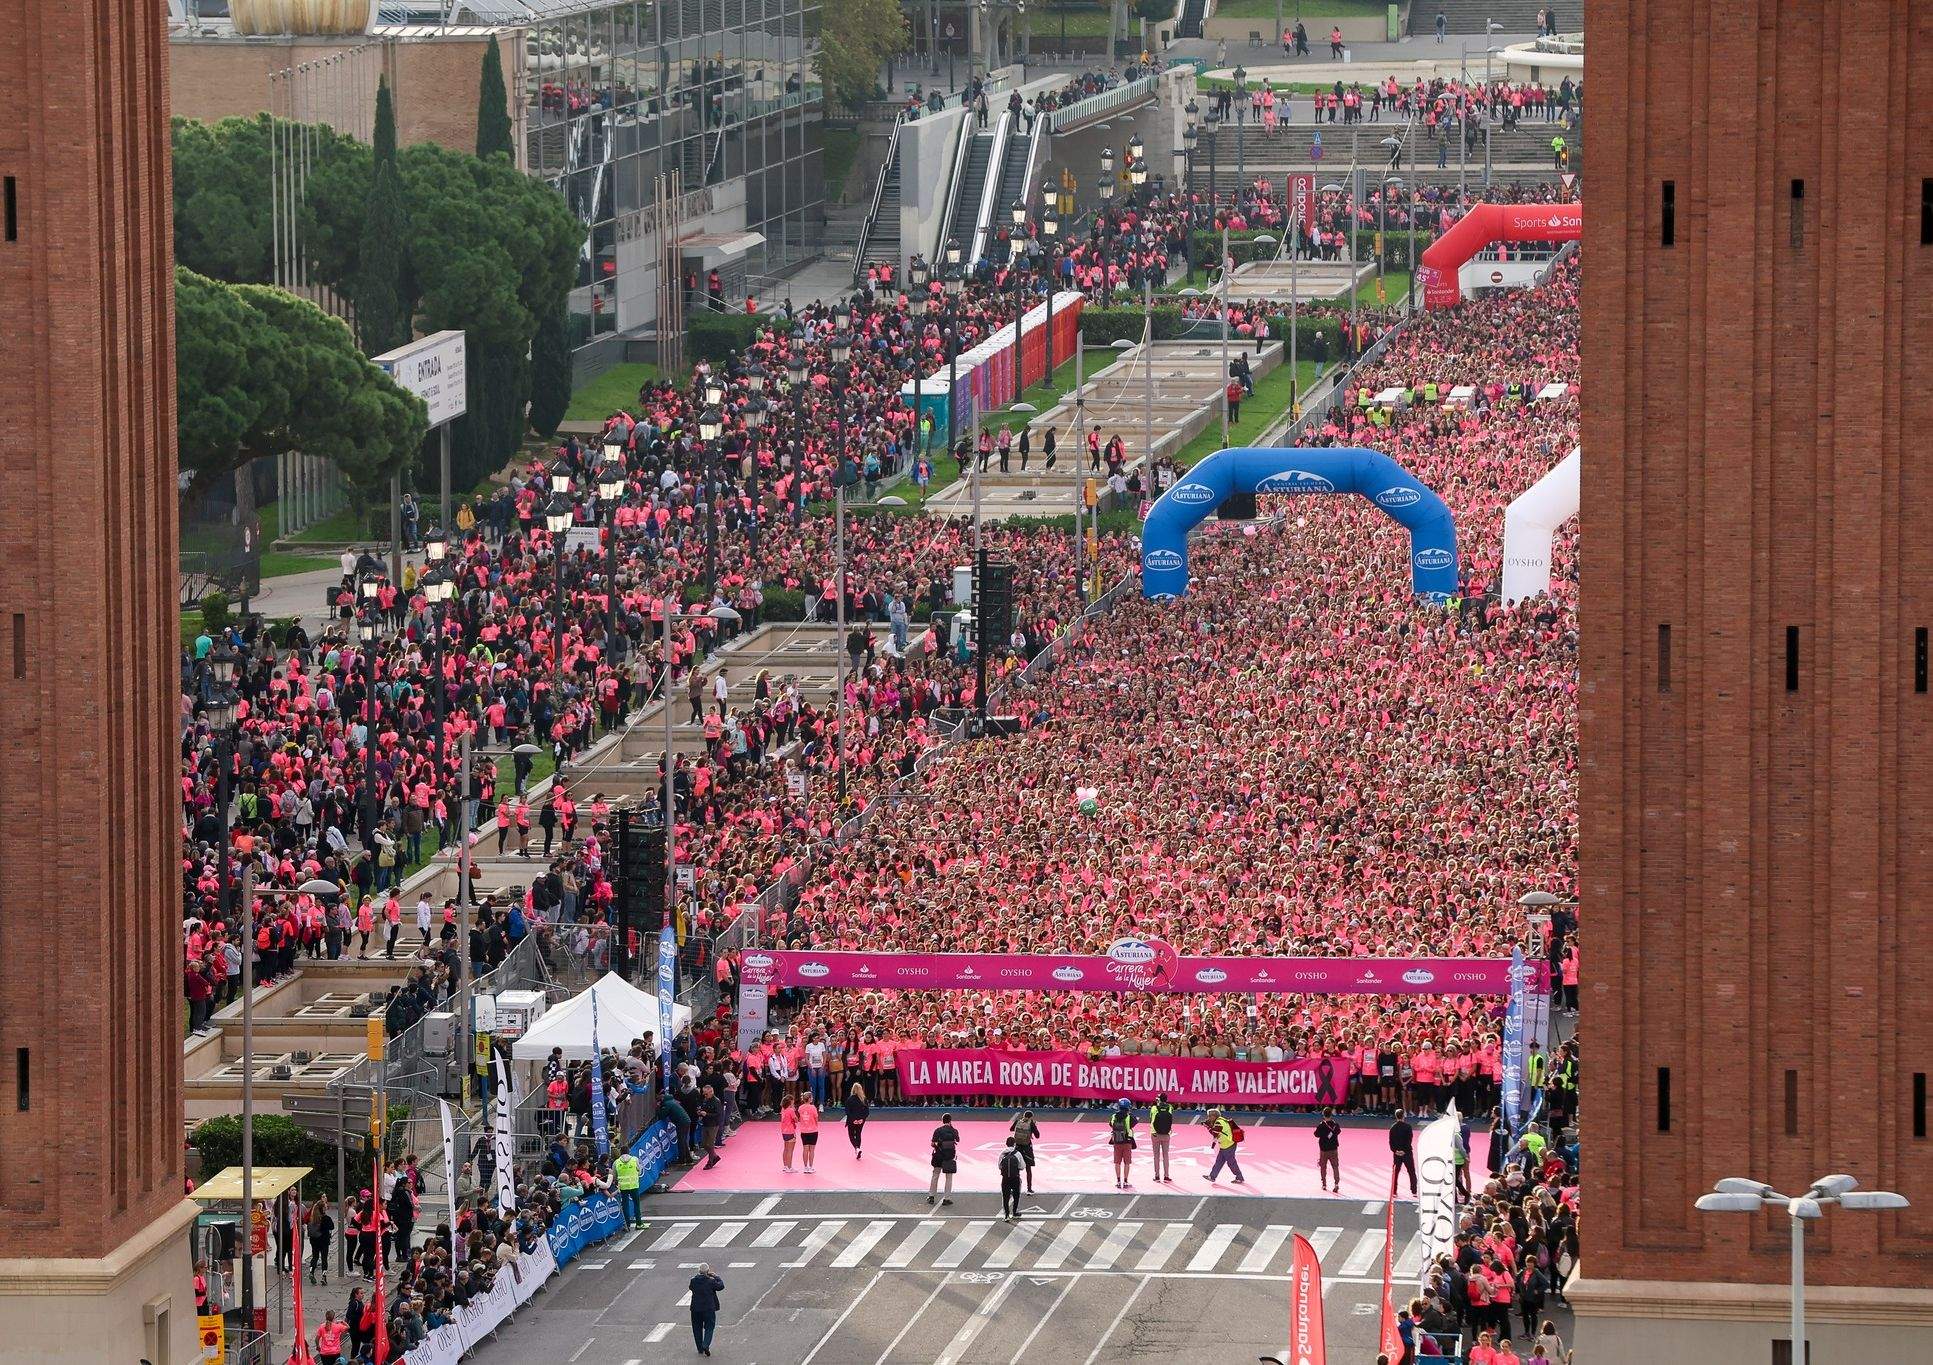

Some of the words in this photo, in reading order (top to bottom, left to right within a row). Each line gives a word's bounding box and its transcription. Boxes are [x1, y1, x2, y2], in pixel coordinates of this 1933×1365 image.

[1514, 218, 1547, 229] Sports
[1262, 483, 1329, 493] ASTURIANA
[1174, 490, 1211, 500] ASTURIANA
[1380, 494, 1418, 503] ASTURIANA
[1147, 557, 1181, 566] ASTURIANA
[1417, 556, 1451, 565] ASTURIANA
[1508, 558, 1543, 567] OYSHO
[1115, 949, 1153, 958] ASTURIANA
[741, 965, 767, 975] Carrera
[800, 966, 828, 974] ASTURIANA
[897, 967, 929, 975] OYSHO
[1106, 961, 1144, 974] Carrera
[1000, 968, 1033, 977] OYSHO
[1055, 970, 1082, 978] ASTURIANA
[1198, 972, 1226, 980] ASTURIANA
[1295, 971, 1328, 980] OYSHO
[1454, 972, 1487, 981] OYSHO
[1128, 972, 1158, 990] Mujer
[909, 1061, 931, 1085] LA
[936, 1060, 994, 1084] MAREA
[1000, 1061, 1045, 1086] ROSA
[1051, 1062, 1072, 1086] DE
[1078, 1064, 1185, 1095] BARCELONA,
[1191, 1069, 1230, 1094] AMB
[1234, 1066, 1319, 1094] VALÈNCIA
